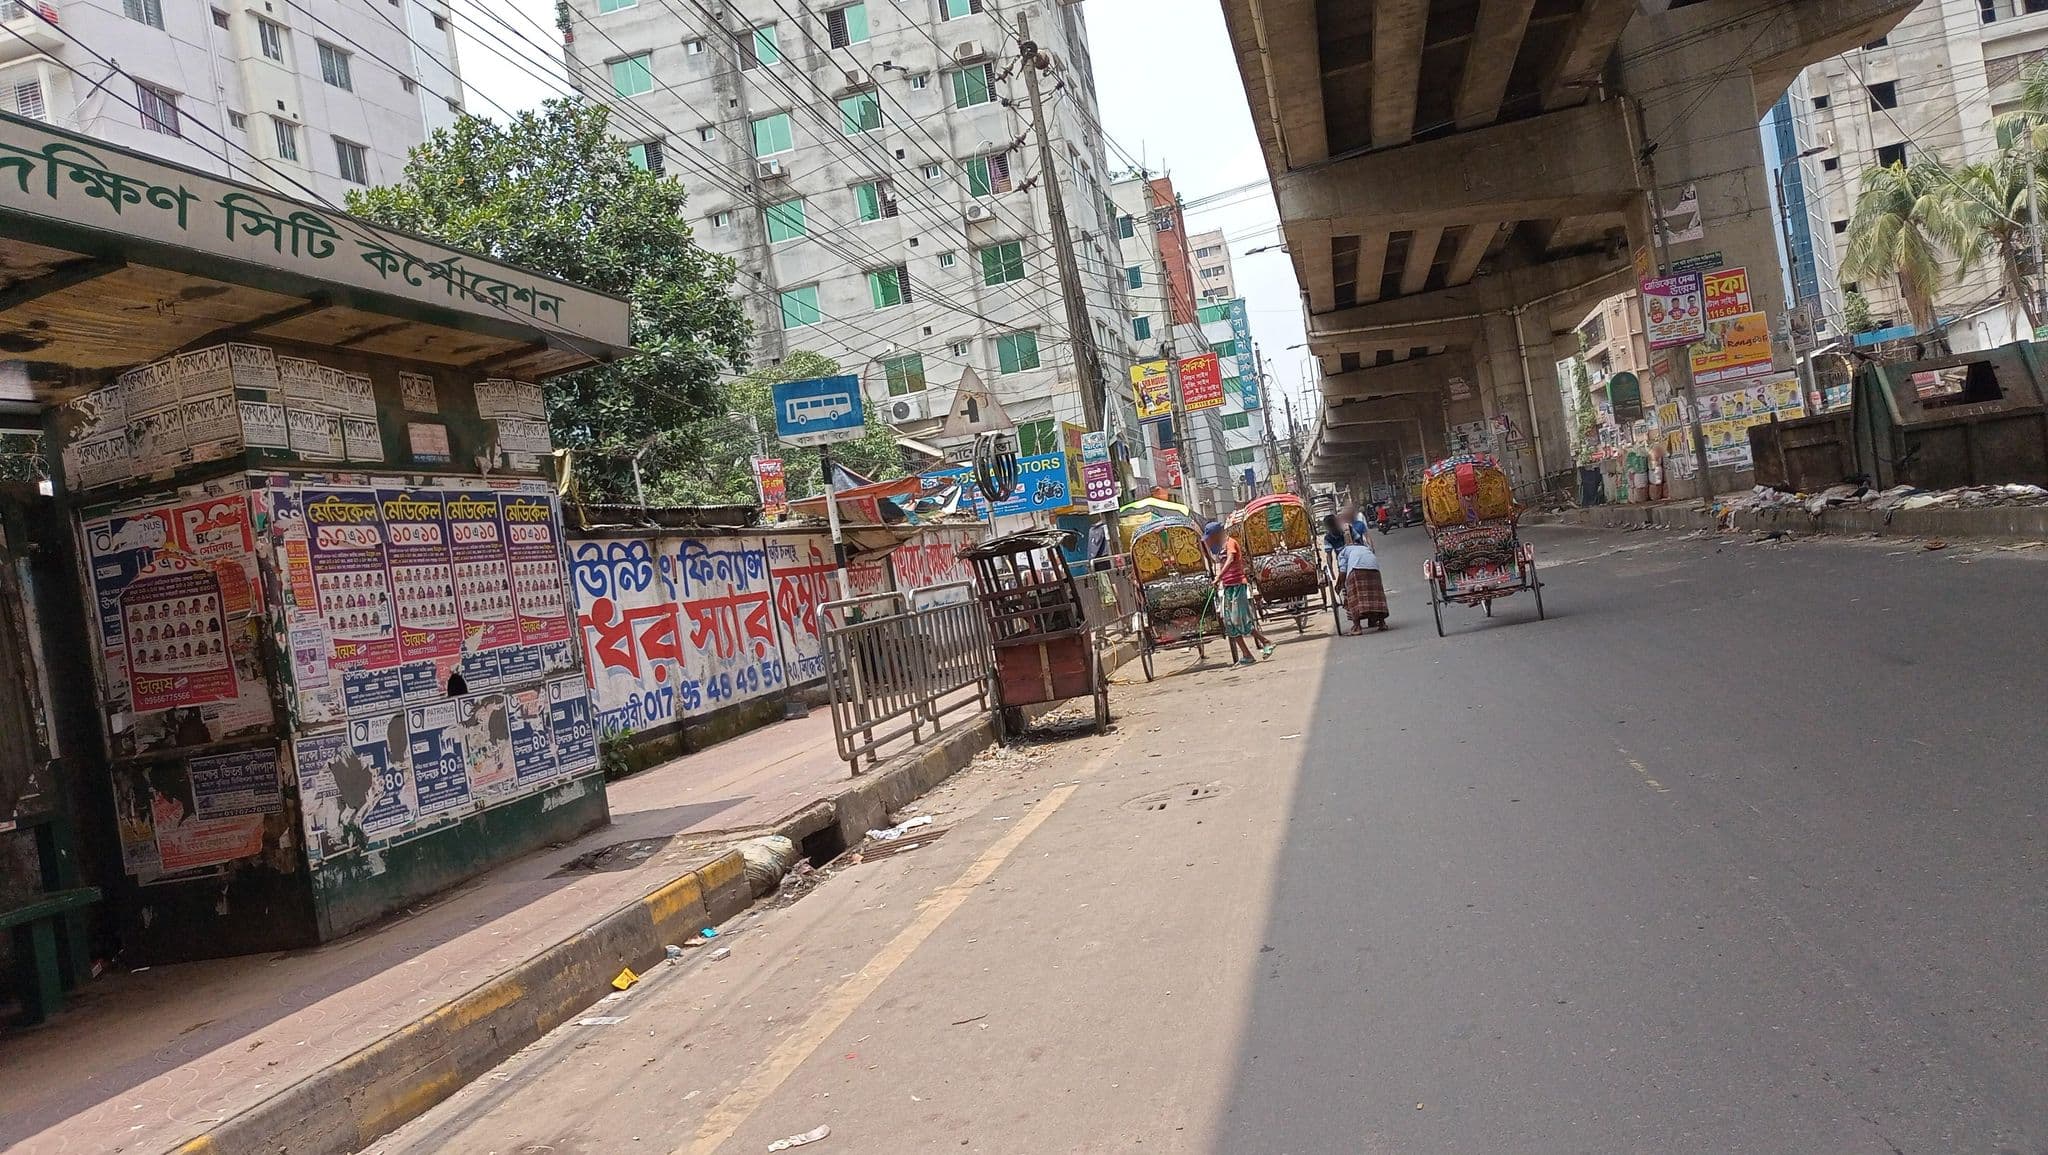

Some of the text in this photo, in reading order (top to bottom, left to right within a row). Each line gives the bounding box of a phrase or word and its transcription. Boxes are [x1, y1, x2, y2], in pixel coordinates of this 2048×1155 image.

[217, 192, 343, 260] সিটি
[358, 240, 566, 324] কর্পোরেশন
[308, 495, 379, 523] মেডিকেল
[383, 494, 442, 521] মেডিকেল
[446, 495, 498, 520] মেডিকেল
[505, 498, 551, 523] মেডিকেল
[391, 526, 412, 543] ১০
[420, 525, 439, 542] ১০
[454, 525, 472, 542] ১০
[479, 524, 495, 541] ১০
[533, 526, 549, 541] ১০
[682, 583, 775, 660] স্যার
[135, 676, 174, 695] উন্মেষ
[643, 686, 673, 722] 017
[706, 670, 732, 703] 48
[736, 662, 759, 693] 49
[763, 659, 783, 688] 50
[573, 724, 586, 740] 80
[532, 734, 546, 751] 80
[440, 758, 457, 776] 80
[385, 772, 404, 790] 80
